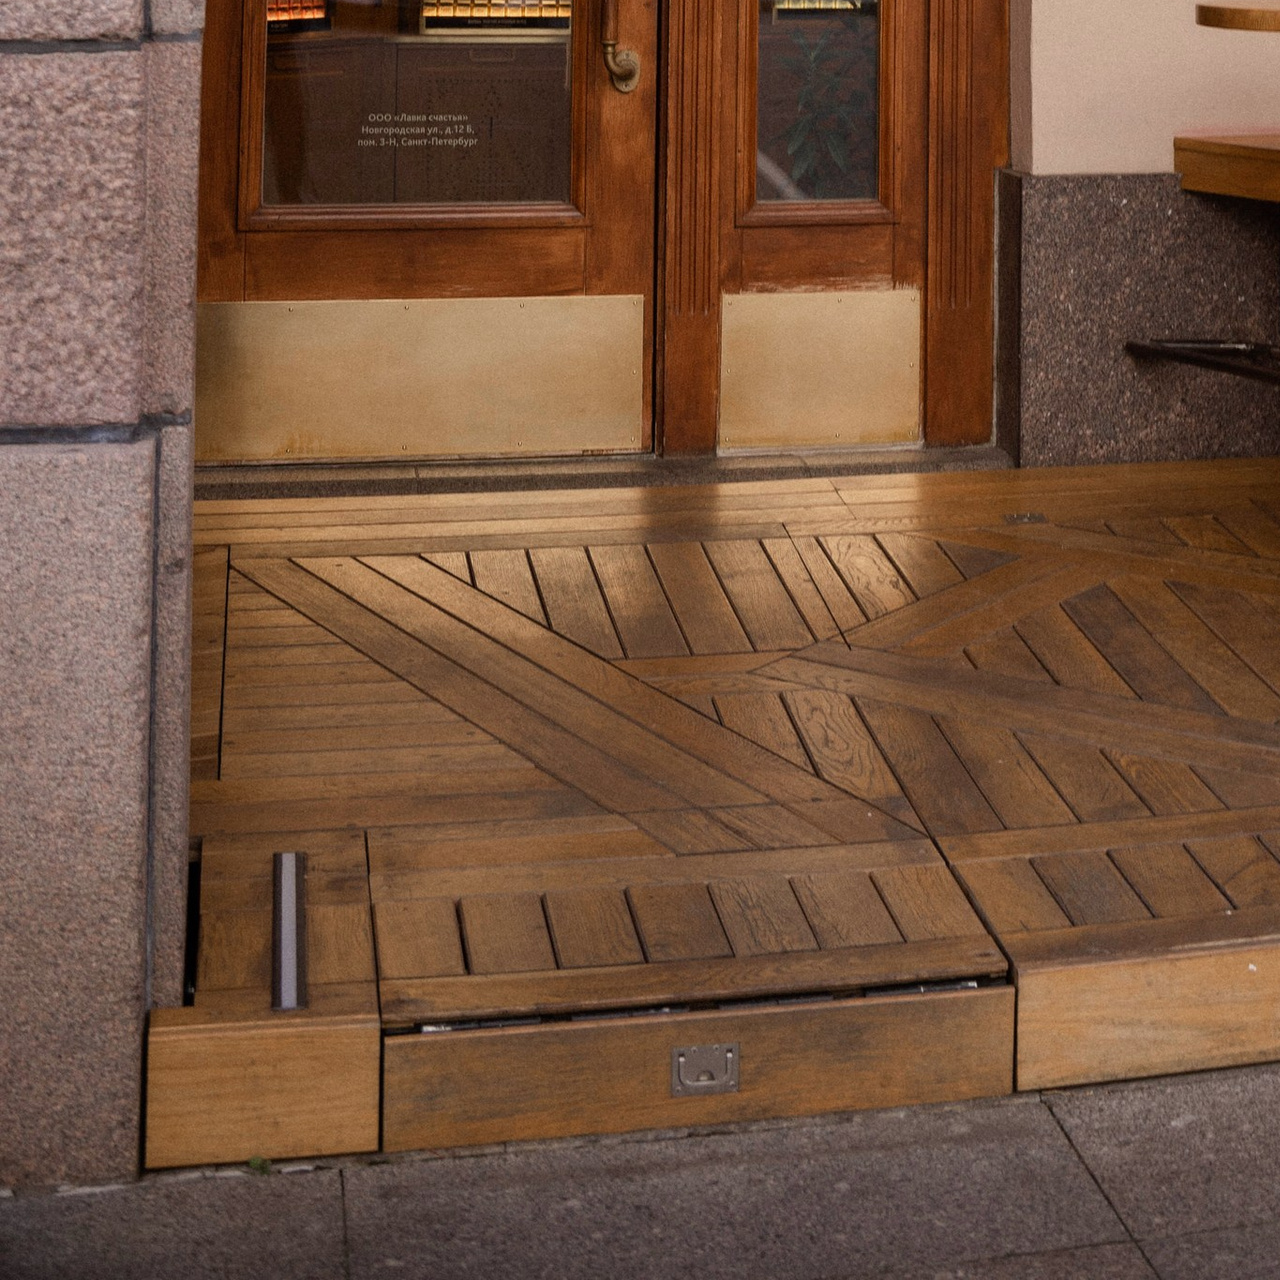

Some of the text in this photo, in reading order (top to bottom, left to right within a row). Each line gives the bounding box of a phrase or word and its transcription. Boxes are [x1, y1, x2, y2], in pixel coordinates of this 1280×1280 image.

[368, 113, 392, 122] ООО
[361, 125, 425, 136] Новгородская
[401, 136, 479, 148] Санкт-Петербург
